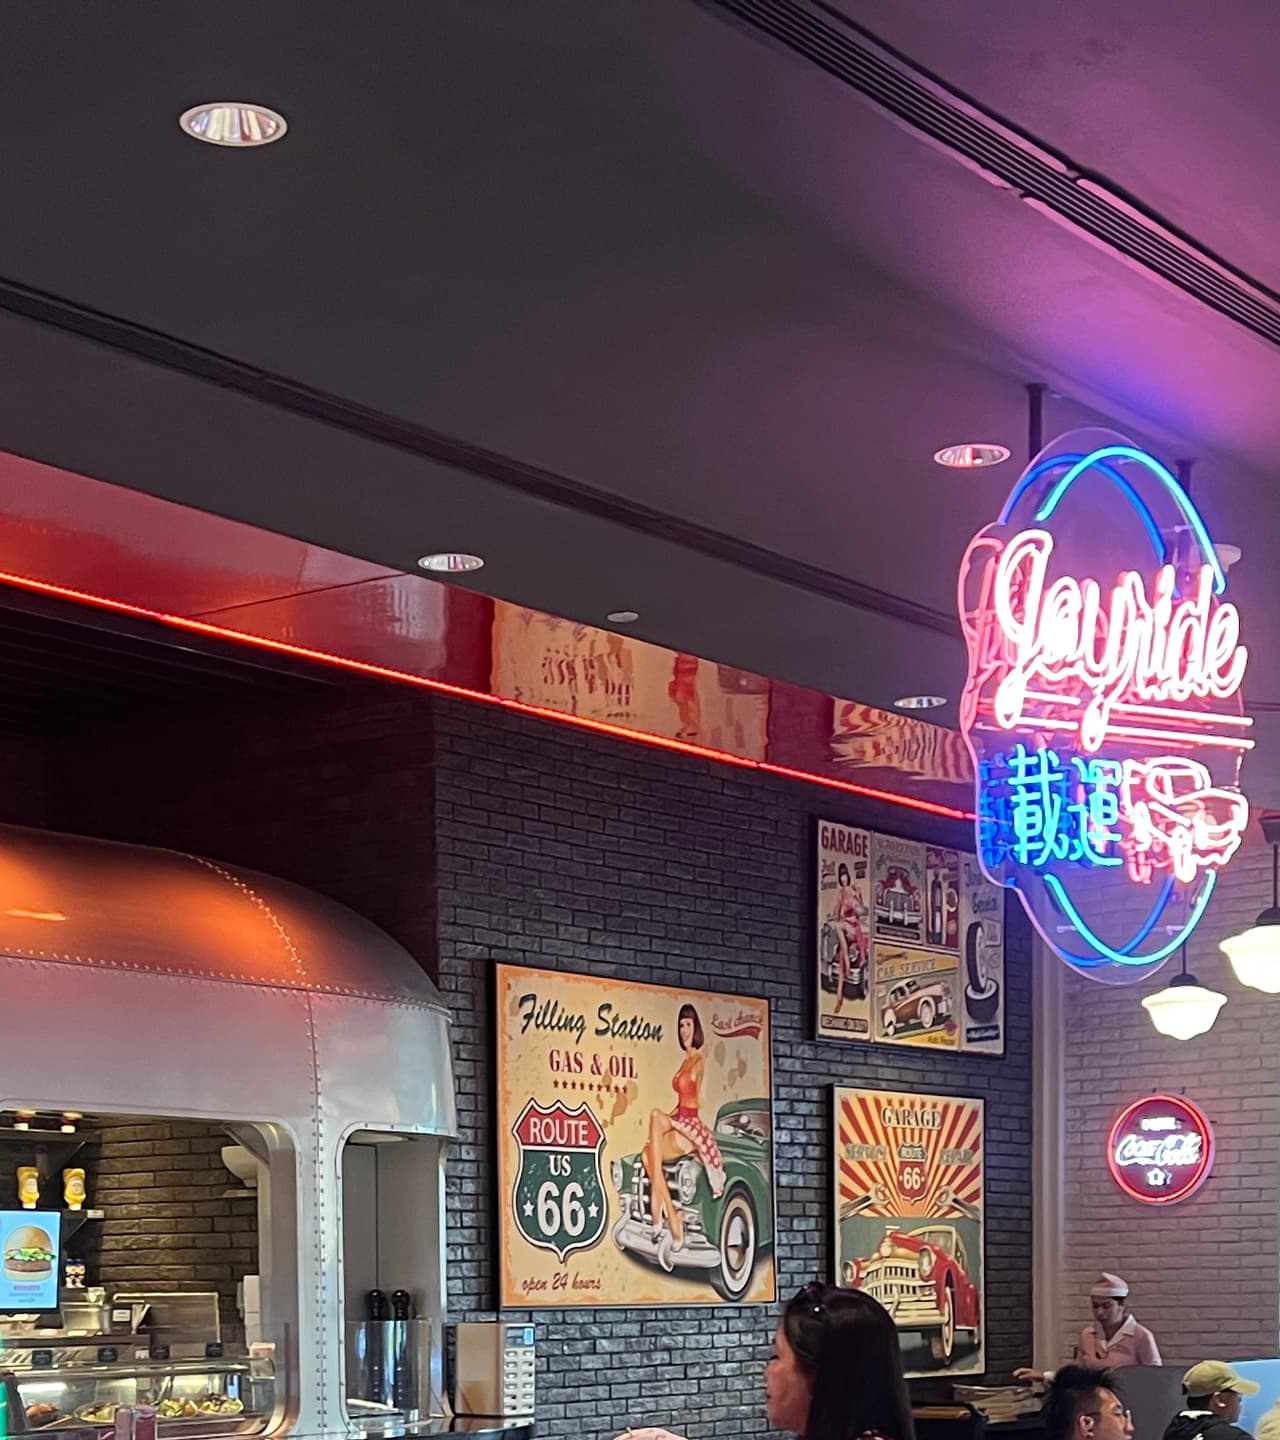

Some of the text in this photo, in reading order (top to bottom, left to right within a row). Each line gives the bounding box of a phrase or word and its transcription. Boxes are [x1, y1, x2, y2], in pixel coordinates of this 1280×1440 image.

[993, 527, 1248, 751] Joyride
[1008, 742, 1124, 868] 載運
[821, 825, 869, 858] GARAGE
[518, 993, 664, 1046] Filling Station
[549, 1049, 639, 1080] GAS & OIL
[529, 1117, 590, 1146] ROUTE
[882, 1107, 942, 1129] GARAGE
[1115, 1131, 1203, 1167] Coca-Cola
[549, 1154, 571, 1177] US
[903, 1166, 922, 1190] 66
[537, 1181, 586, 1237] 66
[522, 1271, 602, 1296] open 24 hours
